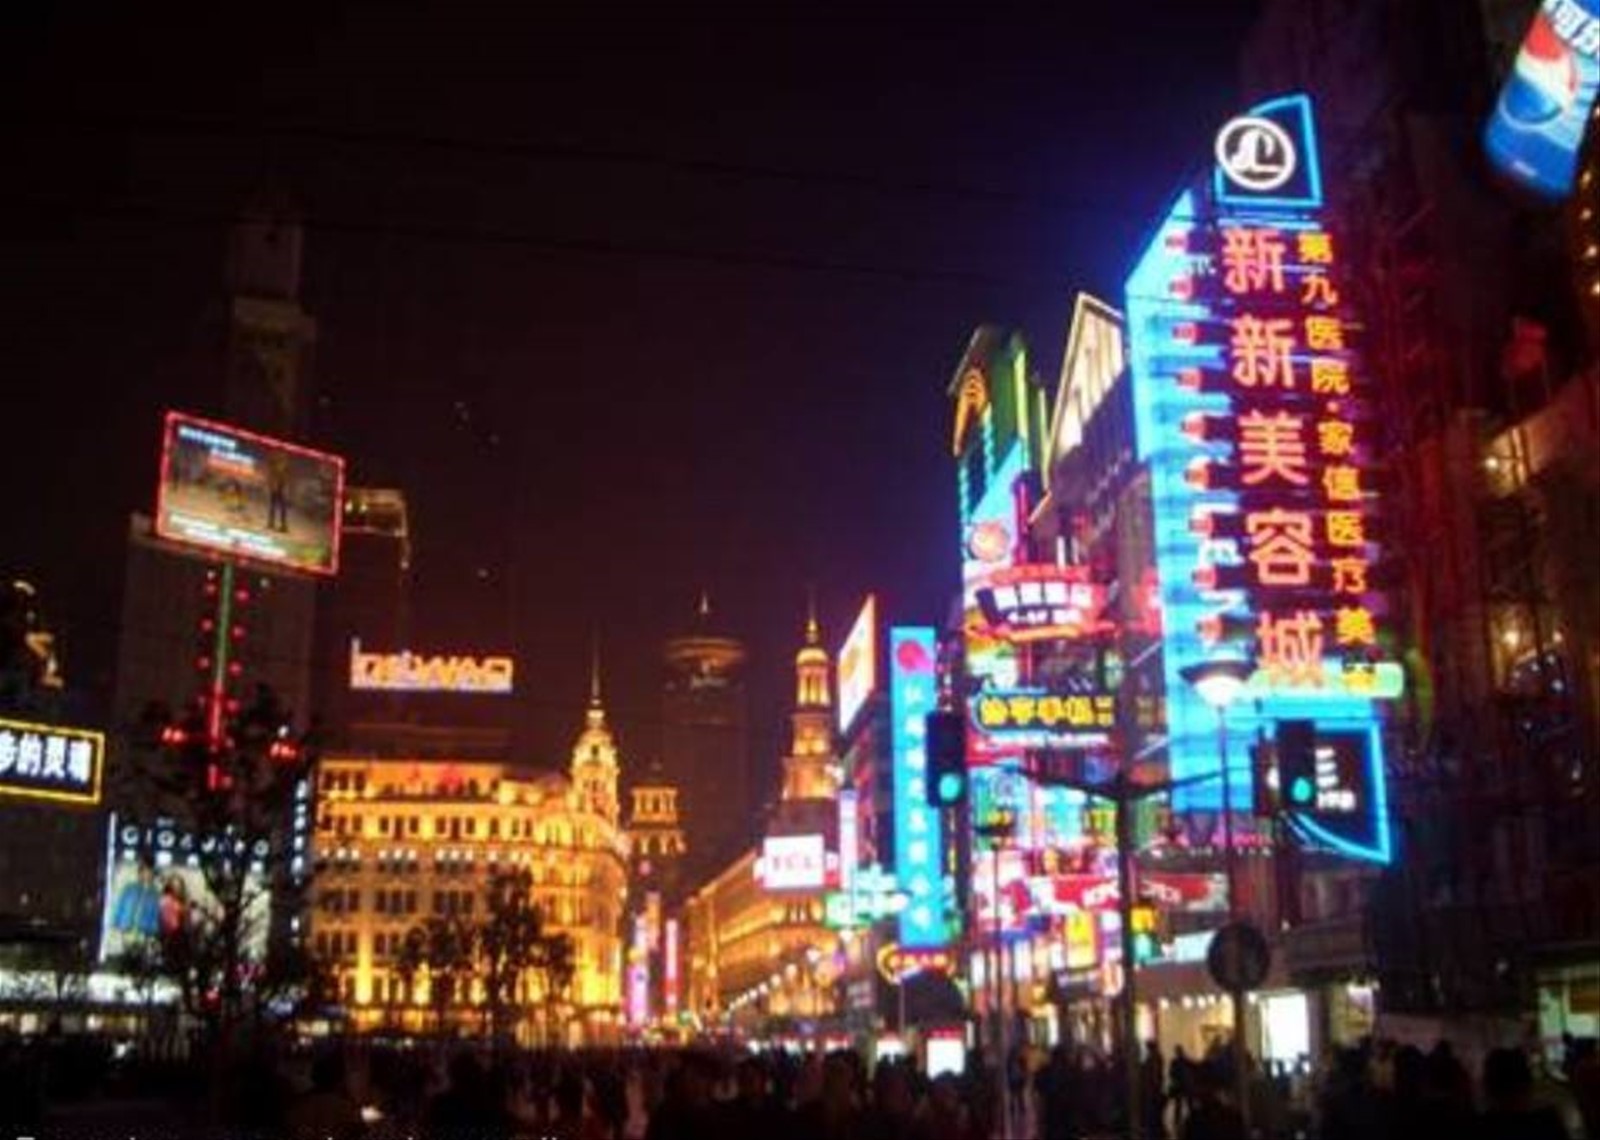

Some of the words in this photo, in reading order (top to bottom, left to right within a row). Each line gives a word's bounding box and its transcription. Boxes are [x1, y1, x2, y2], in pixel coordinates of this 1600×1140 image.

[1221, 227, 1326, 685] 新新美容城
